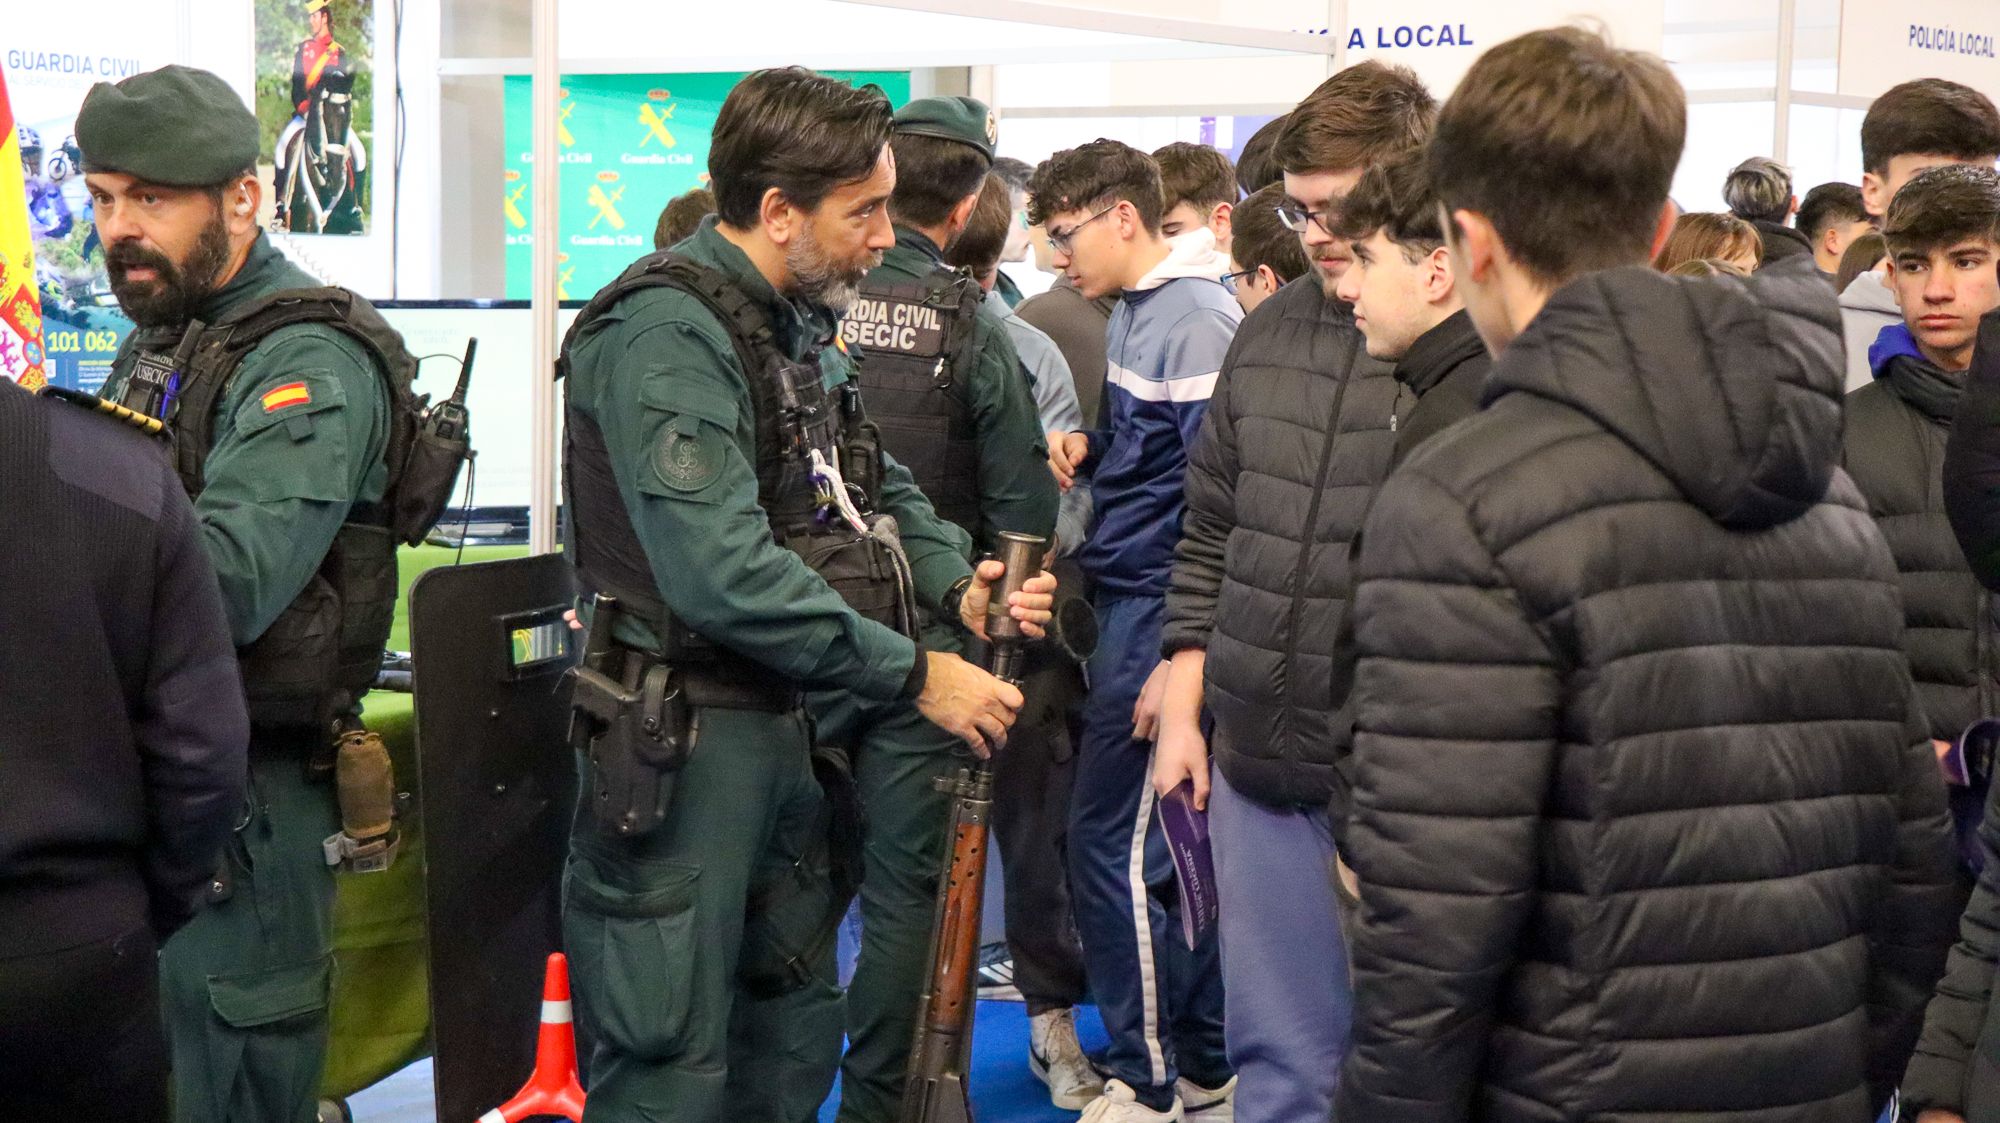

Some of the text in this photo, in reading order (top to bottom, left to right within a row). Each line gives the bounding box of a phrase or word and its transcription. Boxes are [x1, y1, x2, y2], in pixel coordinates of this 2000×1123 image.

[1377, 24, 1474, 49] LOCAL
[1909, 23, 1995, 58] POLICÍA LOCAL
[8, 49, 94, 75] GUARDIA
[566, 153, 592, 163] Civil
[621, 152, 693, 164] Guardia Civil
[571, 234, 643, 246] Guardia Civil
[842, 299, 941, 331] RDIA CIVIL
[48, 331, 118, 353] 101 062
